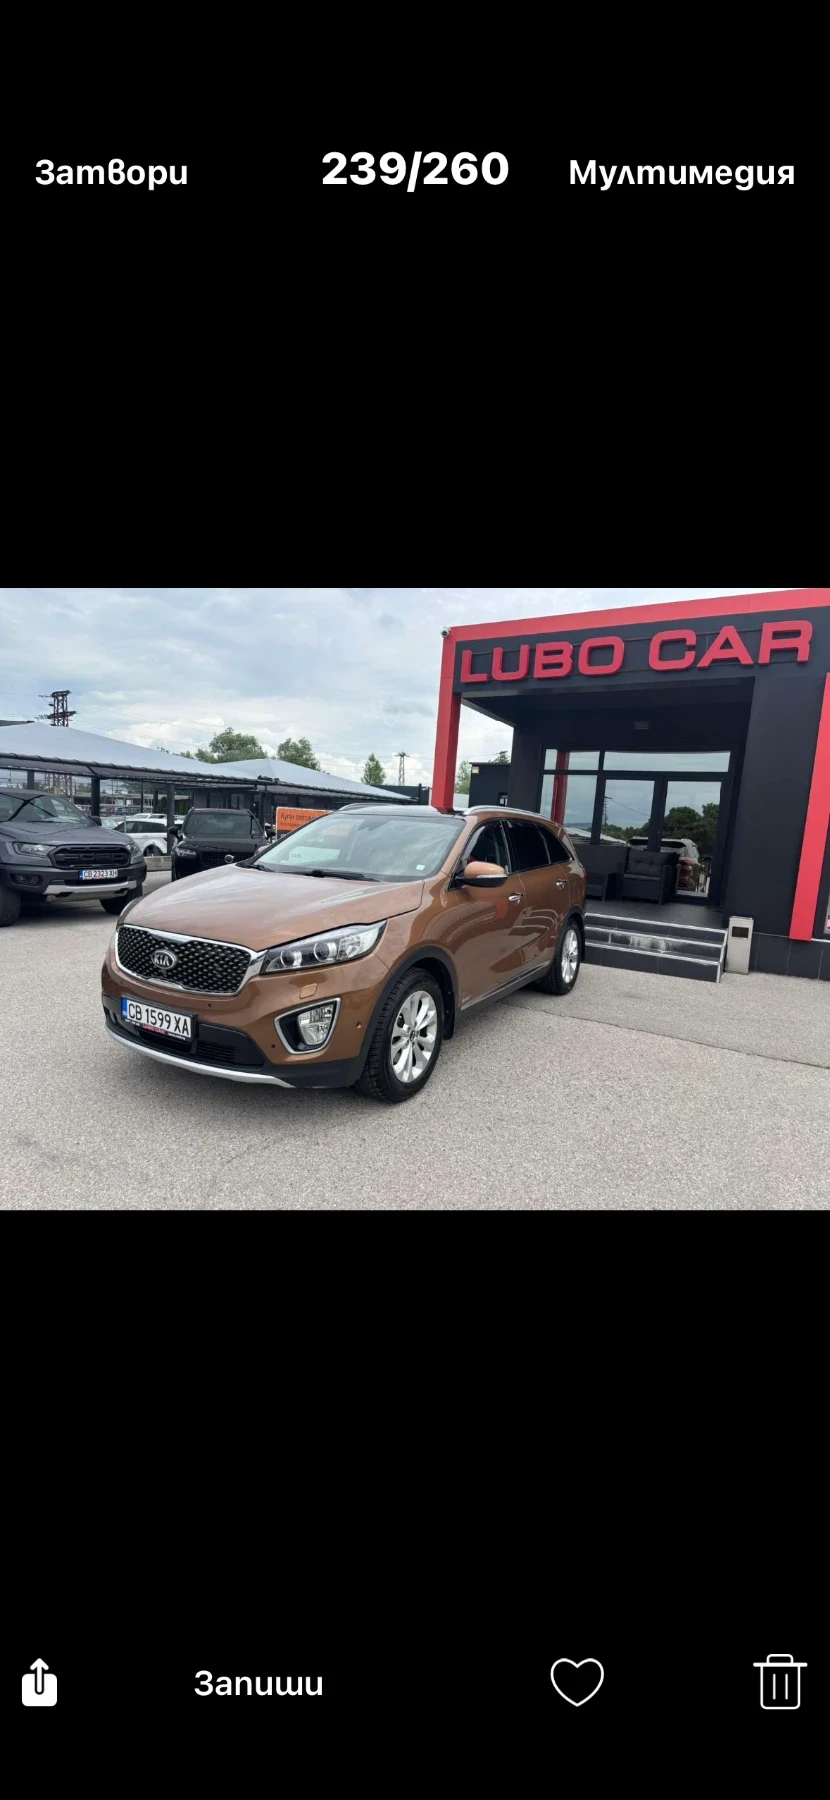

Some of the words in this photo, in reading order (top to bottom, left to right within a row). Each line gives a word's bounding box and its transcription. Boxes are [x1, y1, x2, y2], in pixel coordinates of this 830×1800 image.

[461, 636, 625, 684] LUBO
[648, 619, 813, 671] CAR
[93, 870, 109, 878] 2323
[153, 953, 170, 967] KIA
[128, 1003, 143, 1021] CB
[145, 1008, 171, 1029] 1599
[174, 1016, 189, 1036] XA
